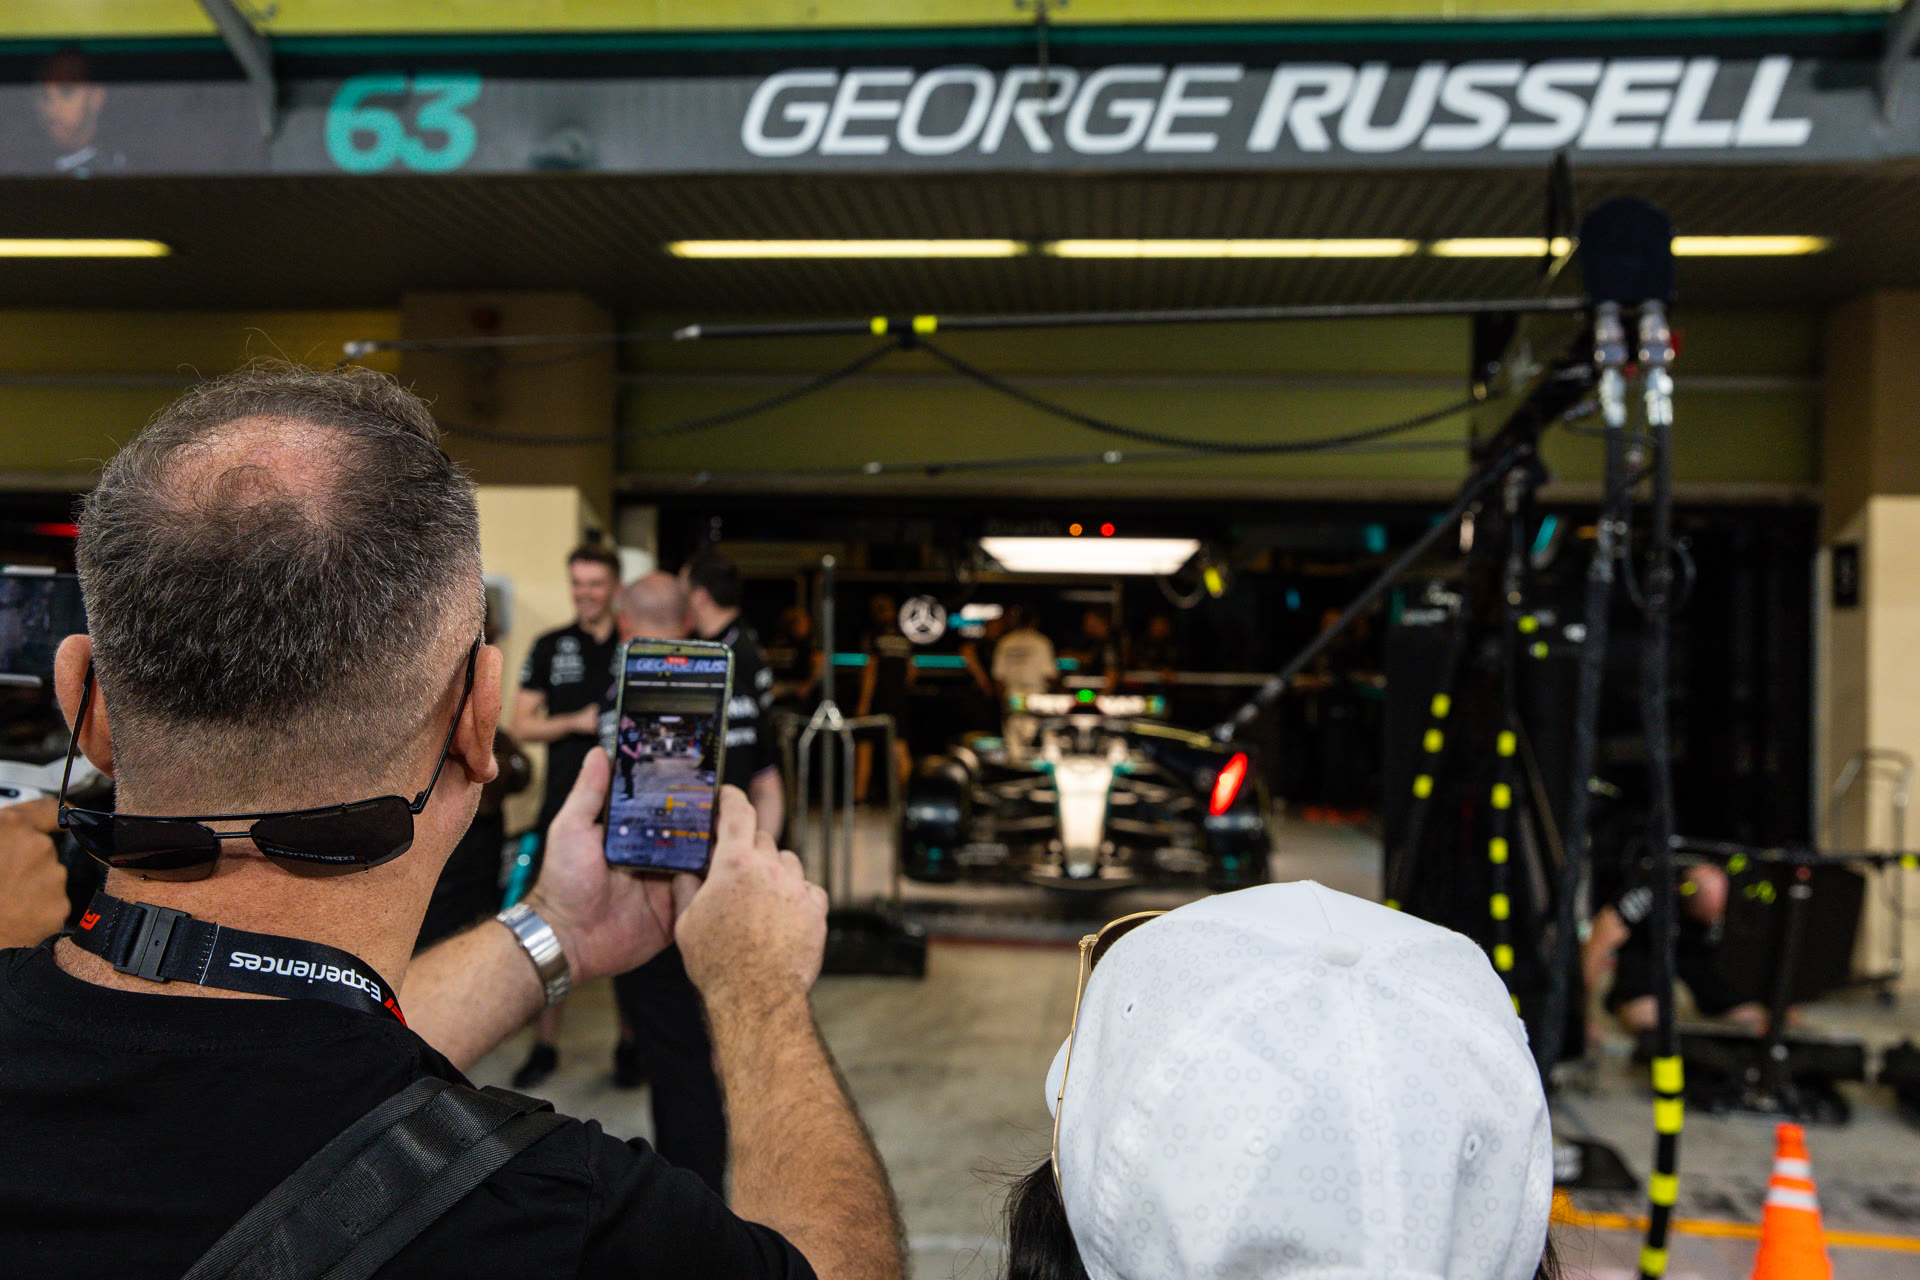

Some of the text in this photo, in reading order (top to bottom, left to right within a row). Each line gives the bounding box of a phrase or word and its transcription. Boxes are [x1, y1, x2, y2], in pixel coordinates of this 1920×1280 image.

[325, 73, 482, 173] 63
[742, 58, 1813, 157] GEORGE RUSSELL
[229, 951, 382, 1003] Experiences
